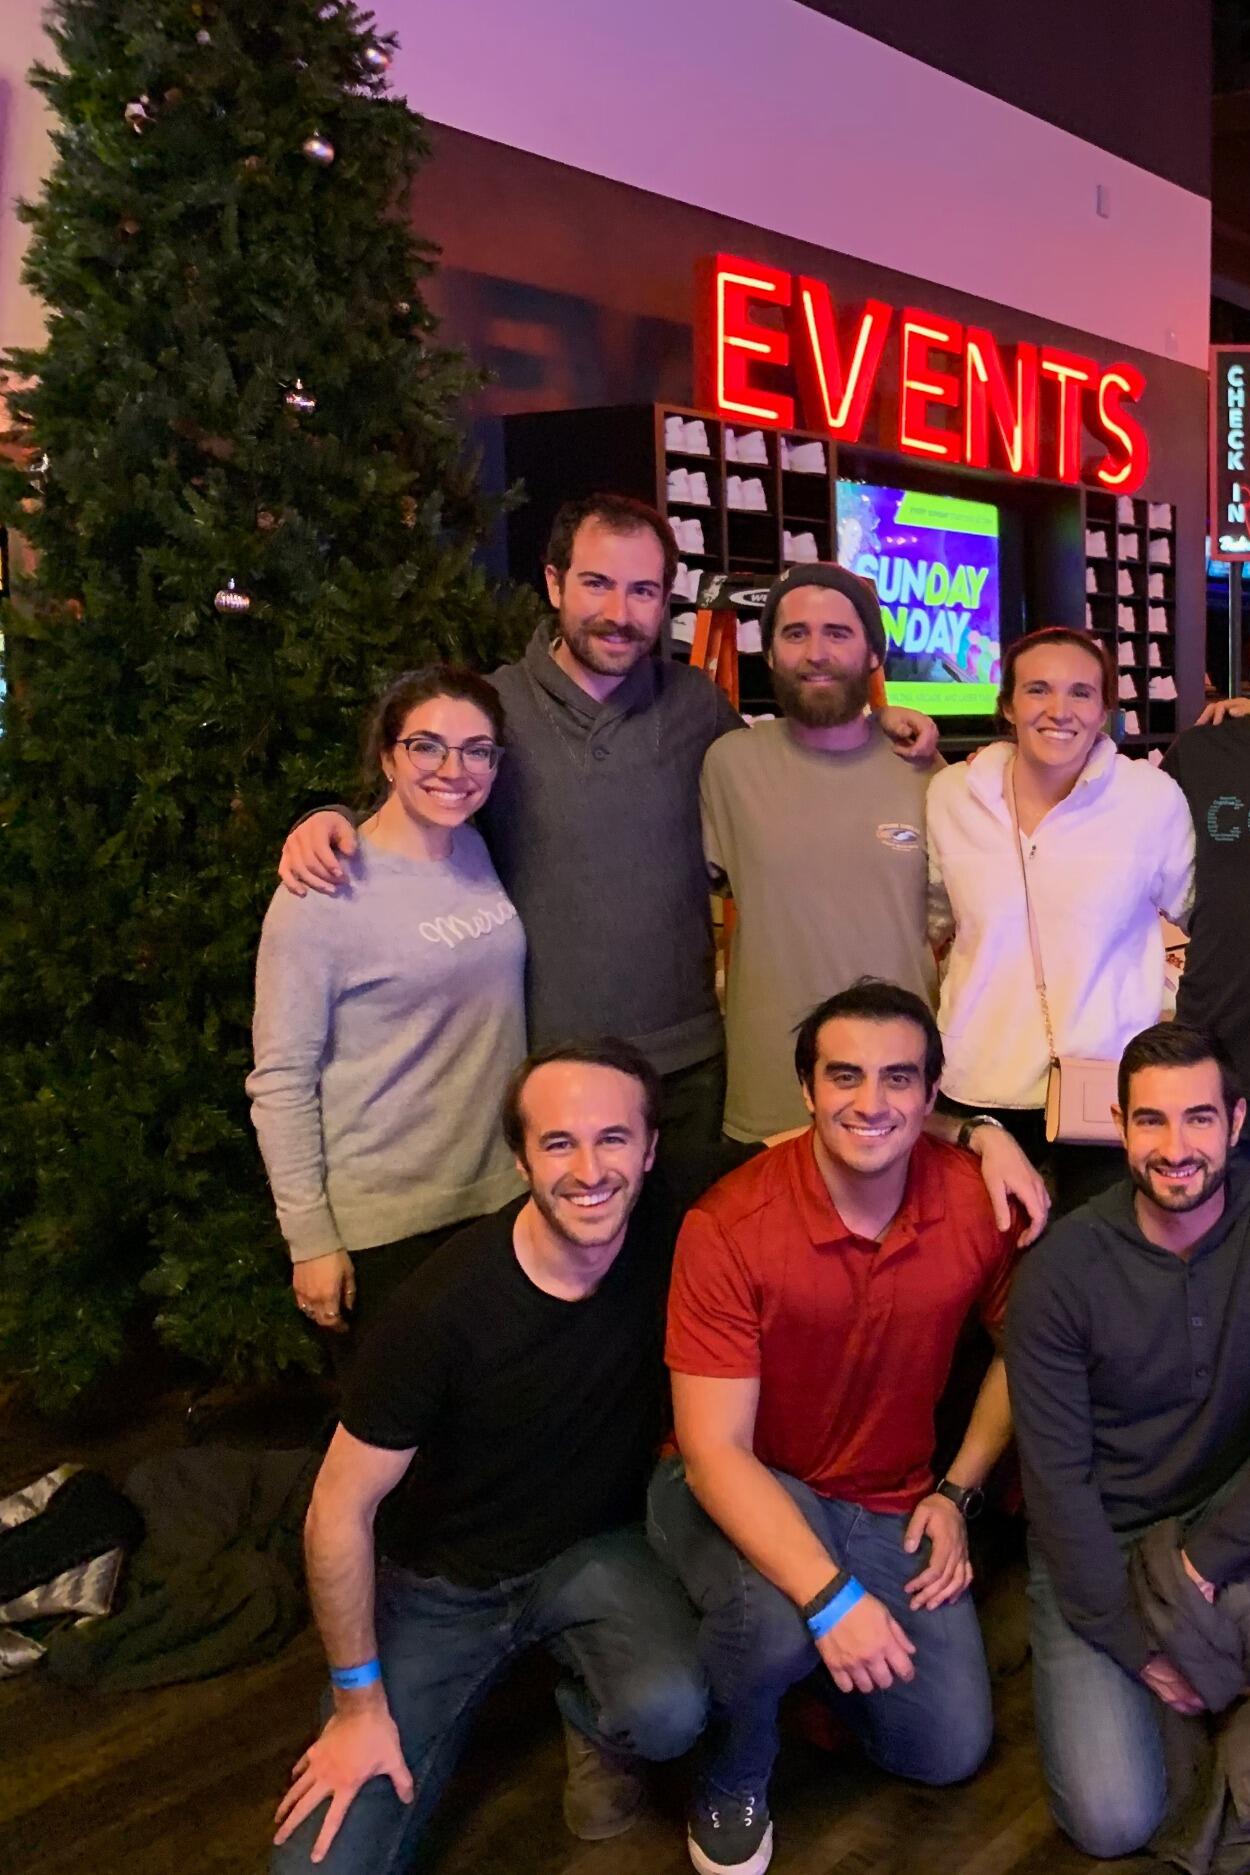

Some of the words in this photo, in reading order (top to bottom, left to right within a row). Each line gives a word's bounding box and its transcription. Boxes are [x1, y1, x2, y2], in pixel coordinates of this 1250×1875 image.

[710, 252, 1150, 495] EVENTS
[1226, 364, 1246, 471] CHECK
[1226, 482, 1246, 523] IN
[854, 553, 990, 610] SUNDAY
[879, 605, 972, 655] NDAY
